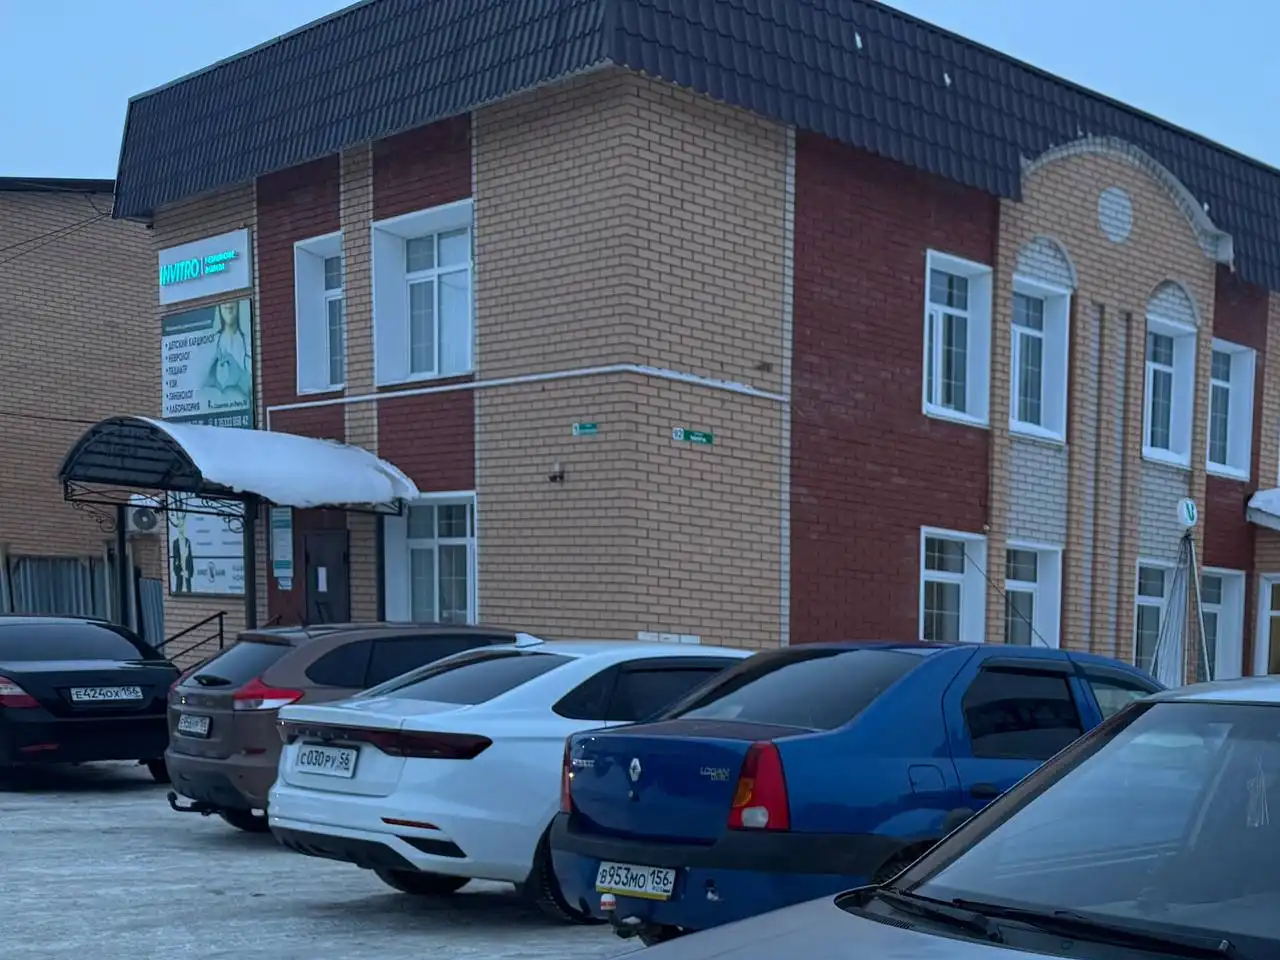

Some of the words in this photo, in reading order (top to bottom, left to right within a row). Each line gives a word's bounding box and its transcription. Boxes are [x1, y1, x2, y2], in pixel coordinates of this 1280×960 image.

[160, 259, 200, 286] INVITRO
[76, 687, 120, 699] Е424ОХ
[122, 686, 138, 697] 156
[600, 866, 646, 888] В953МО
[650, 869, 669, 886] 156
